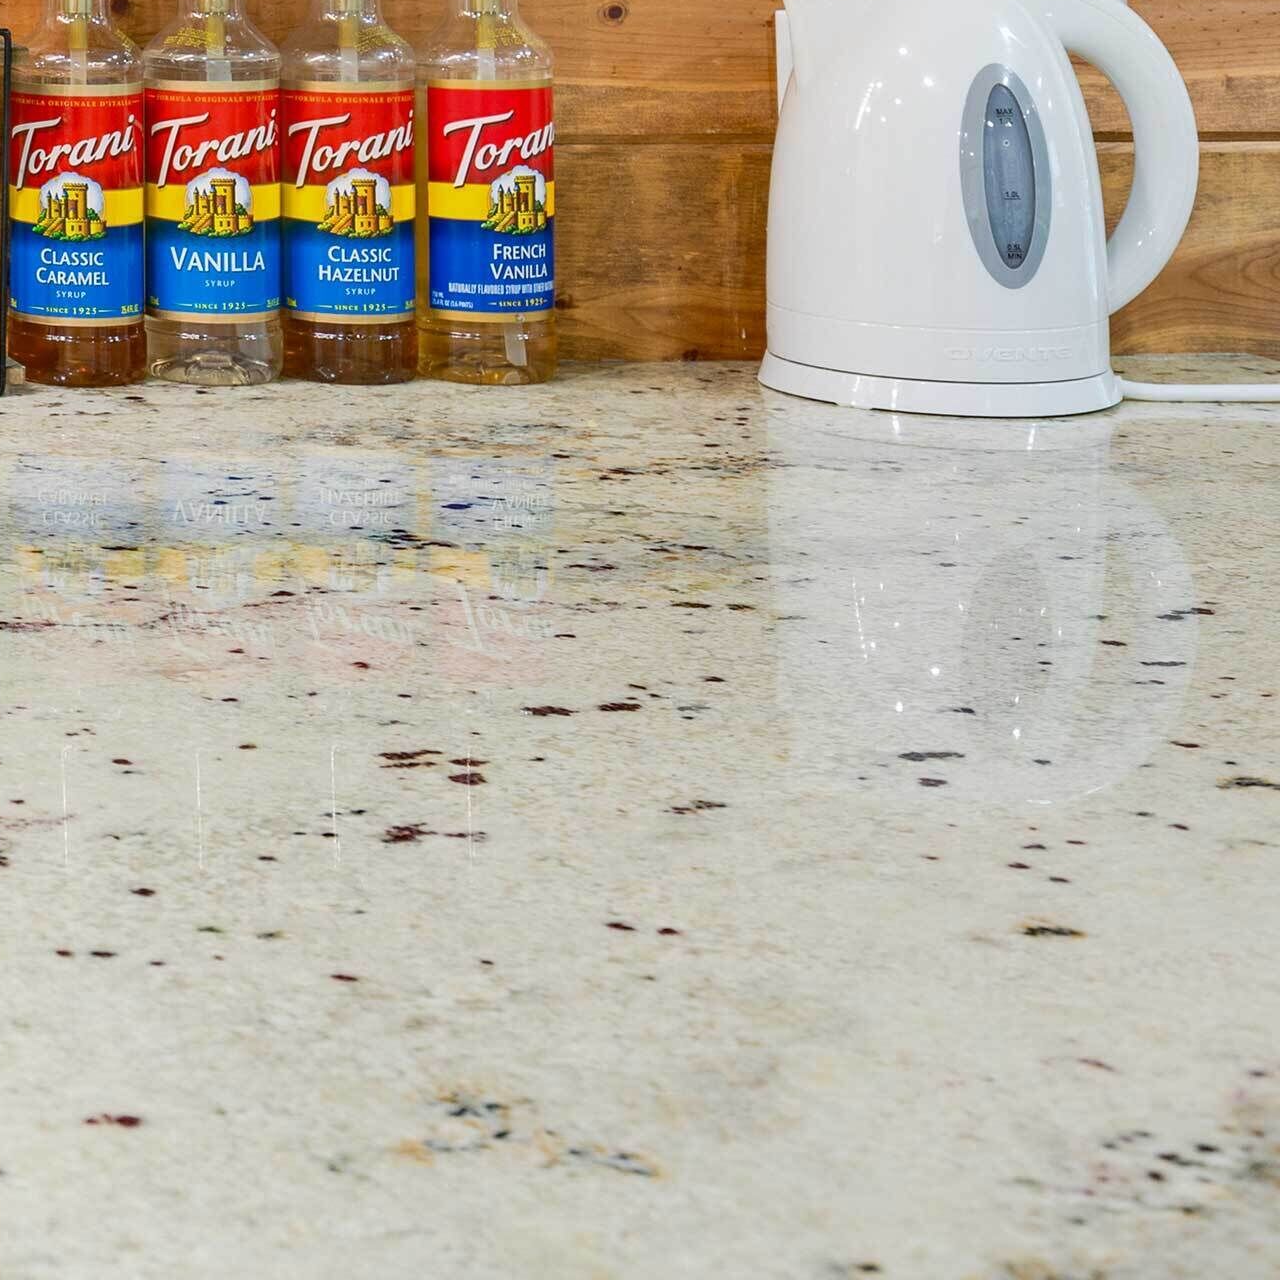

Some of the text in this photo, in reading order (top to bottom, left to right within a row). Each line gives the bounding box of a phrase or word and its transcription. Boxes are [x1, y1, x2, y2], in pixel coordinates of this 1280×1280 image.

[12, 114, 135, 191] Torani
[151, 108, 277, 189] Torani
[288, 109, 414, 189] Torani
[443, 109, 555, 188] Toran
[41, 248, 104, 266] CLASSIC
[170, 246, 265, 272] VANILLA
[328, 245, 392, 263] CLASSIC
[493, 243, 546, 260] FRENCH
[36, 267, 109, 286] CARAMEL
[319, 265, 400, 282] HAZELNUT
[490, 263, 548, 280] VANILLA
[204, 279, 236, 287] SYRUP
[345, 287, 376, 296] SYRUP
[56, 290, 86, 298] SYRUP
[525, 298, 543, 307] 1925
[46, 306, 97, 315] SINCE 1925
[194, 302, 246, 310] SINCE 1925
[363, 303, 387, 312] 1925
